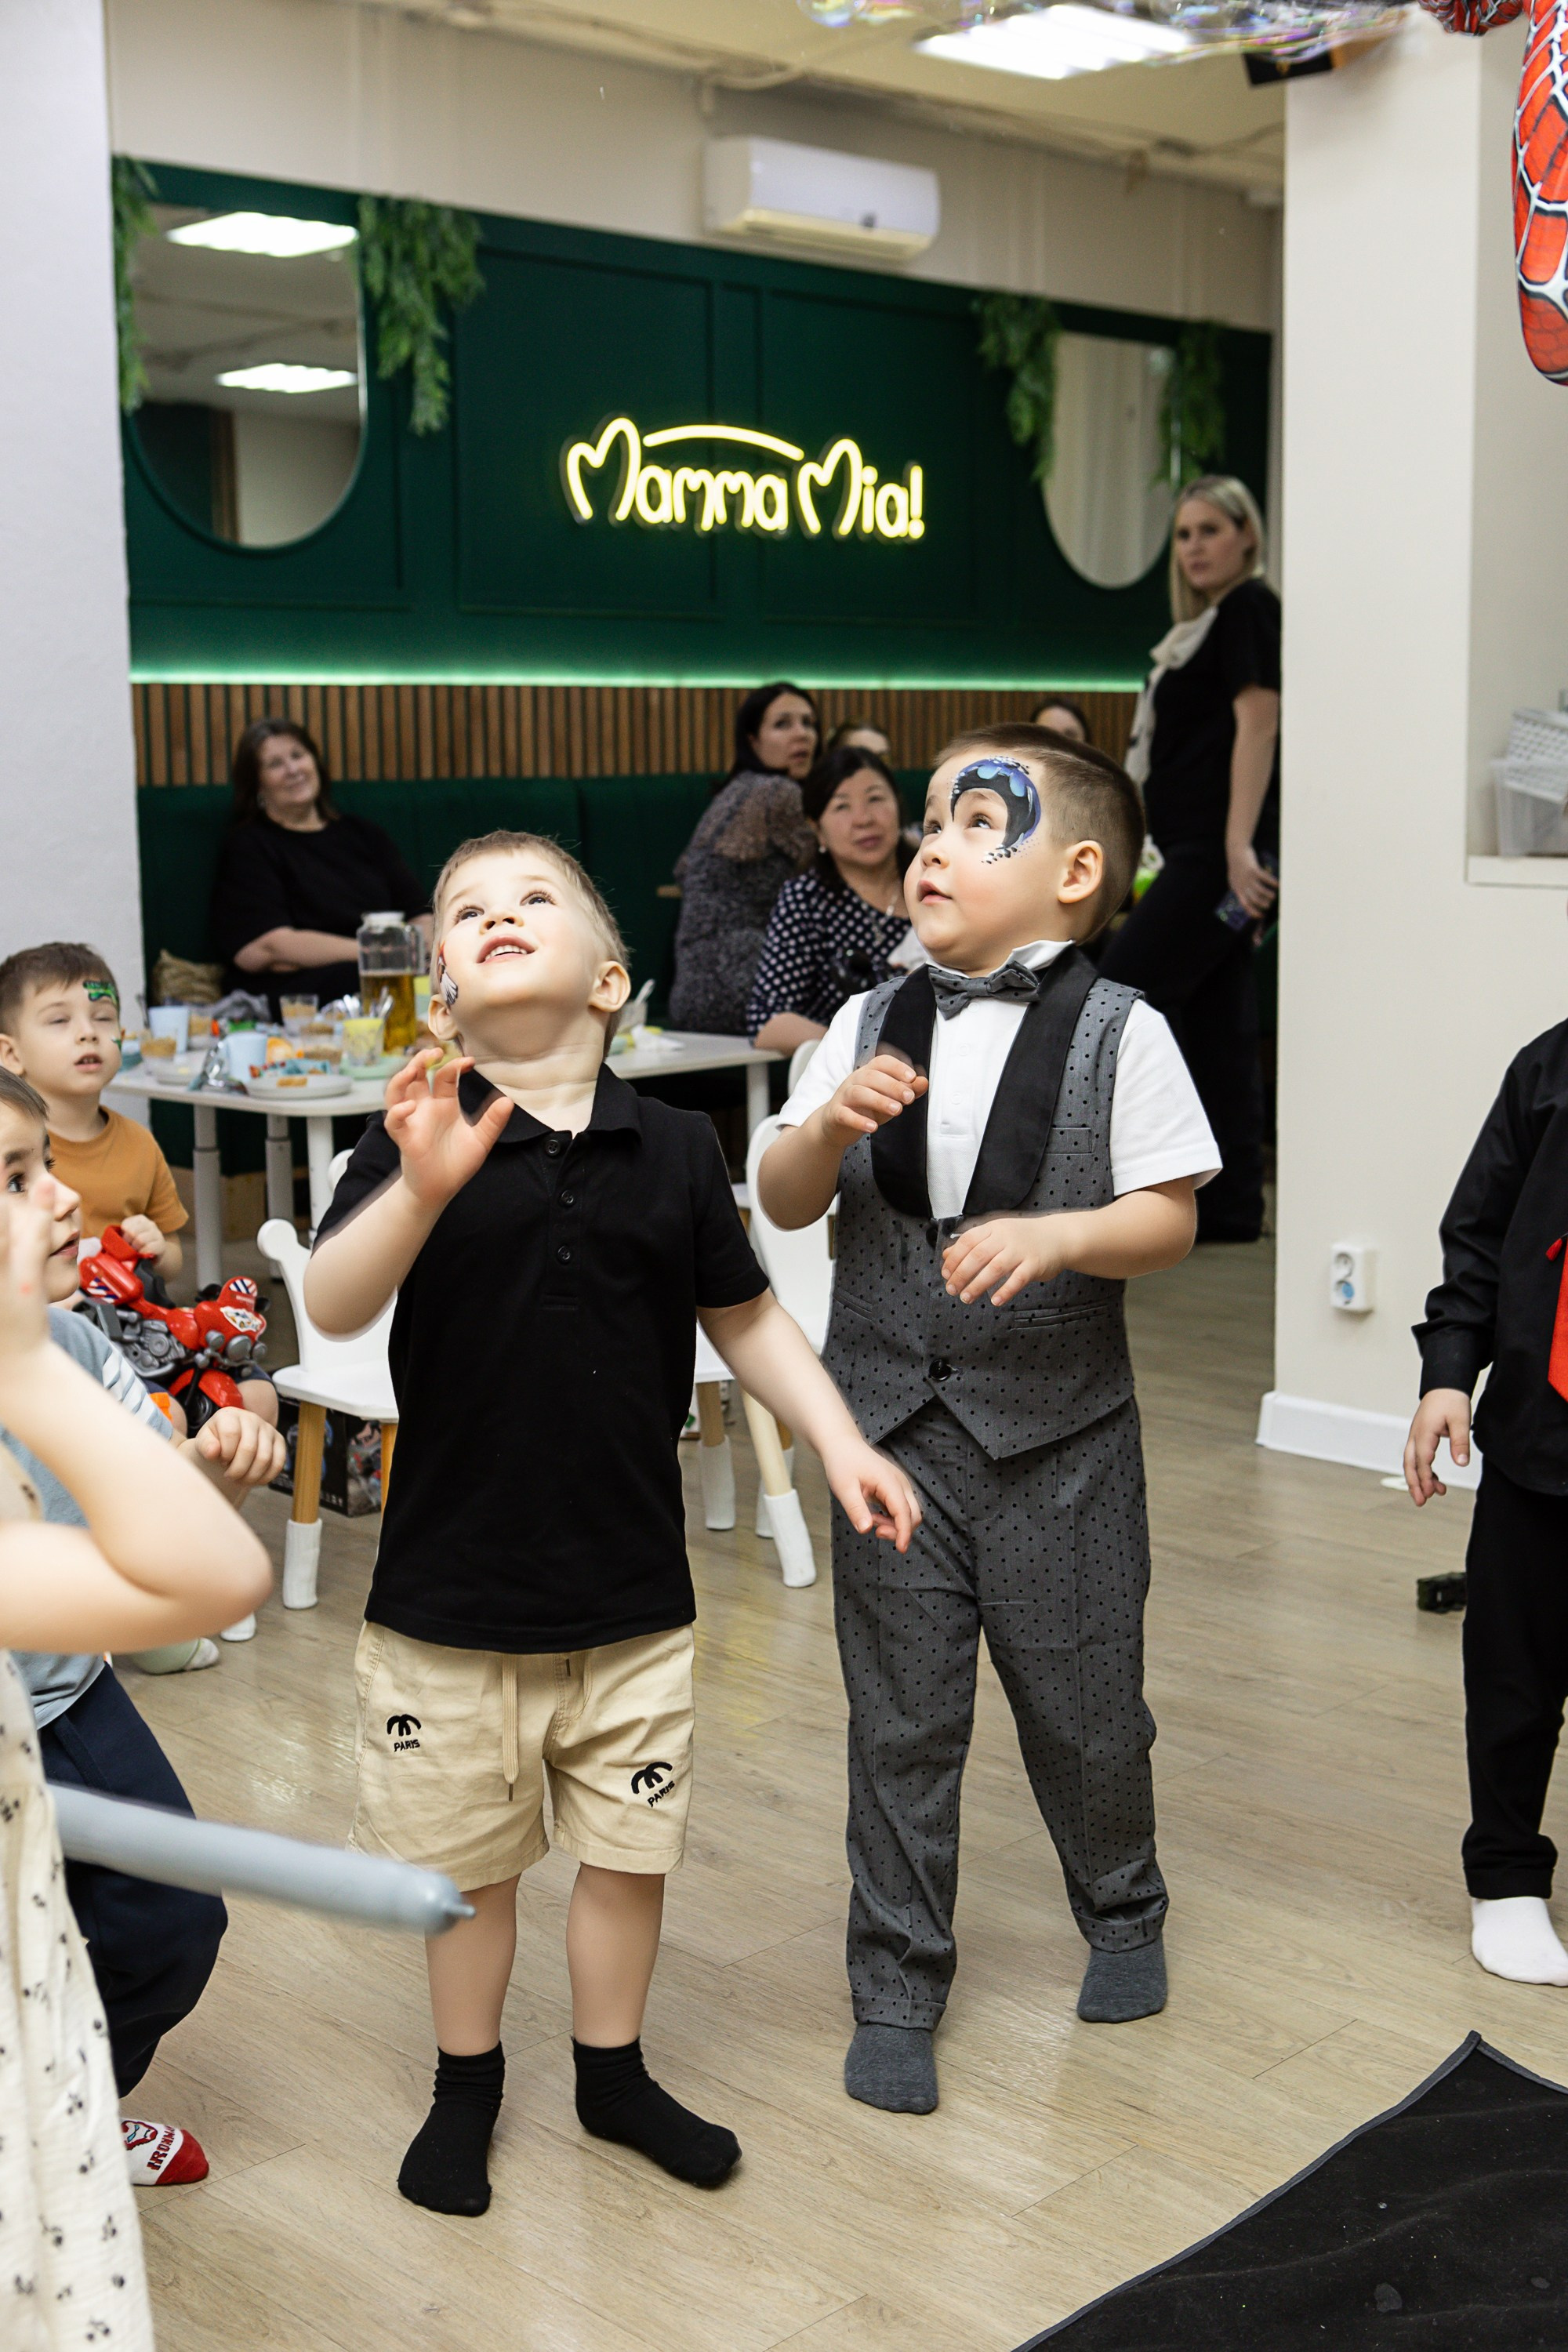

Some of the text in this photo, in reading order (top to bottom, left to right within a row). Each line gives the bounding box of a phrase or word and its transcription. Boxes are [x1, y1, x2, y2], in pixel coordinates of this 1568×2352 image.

[566, 416, 925, 539] Mamma Mia!
[394, 1739, 421, 1752] PARIS
[647, 1780, 676, 1808] PARIS
